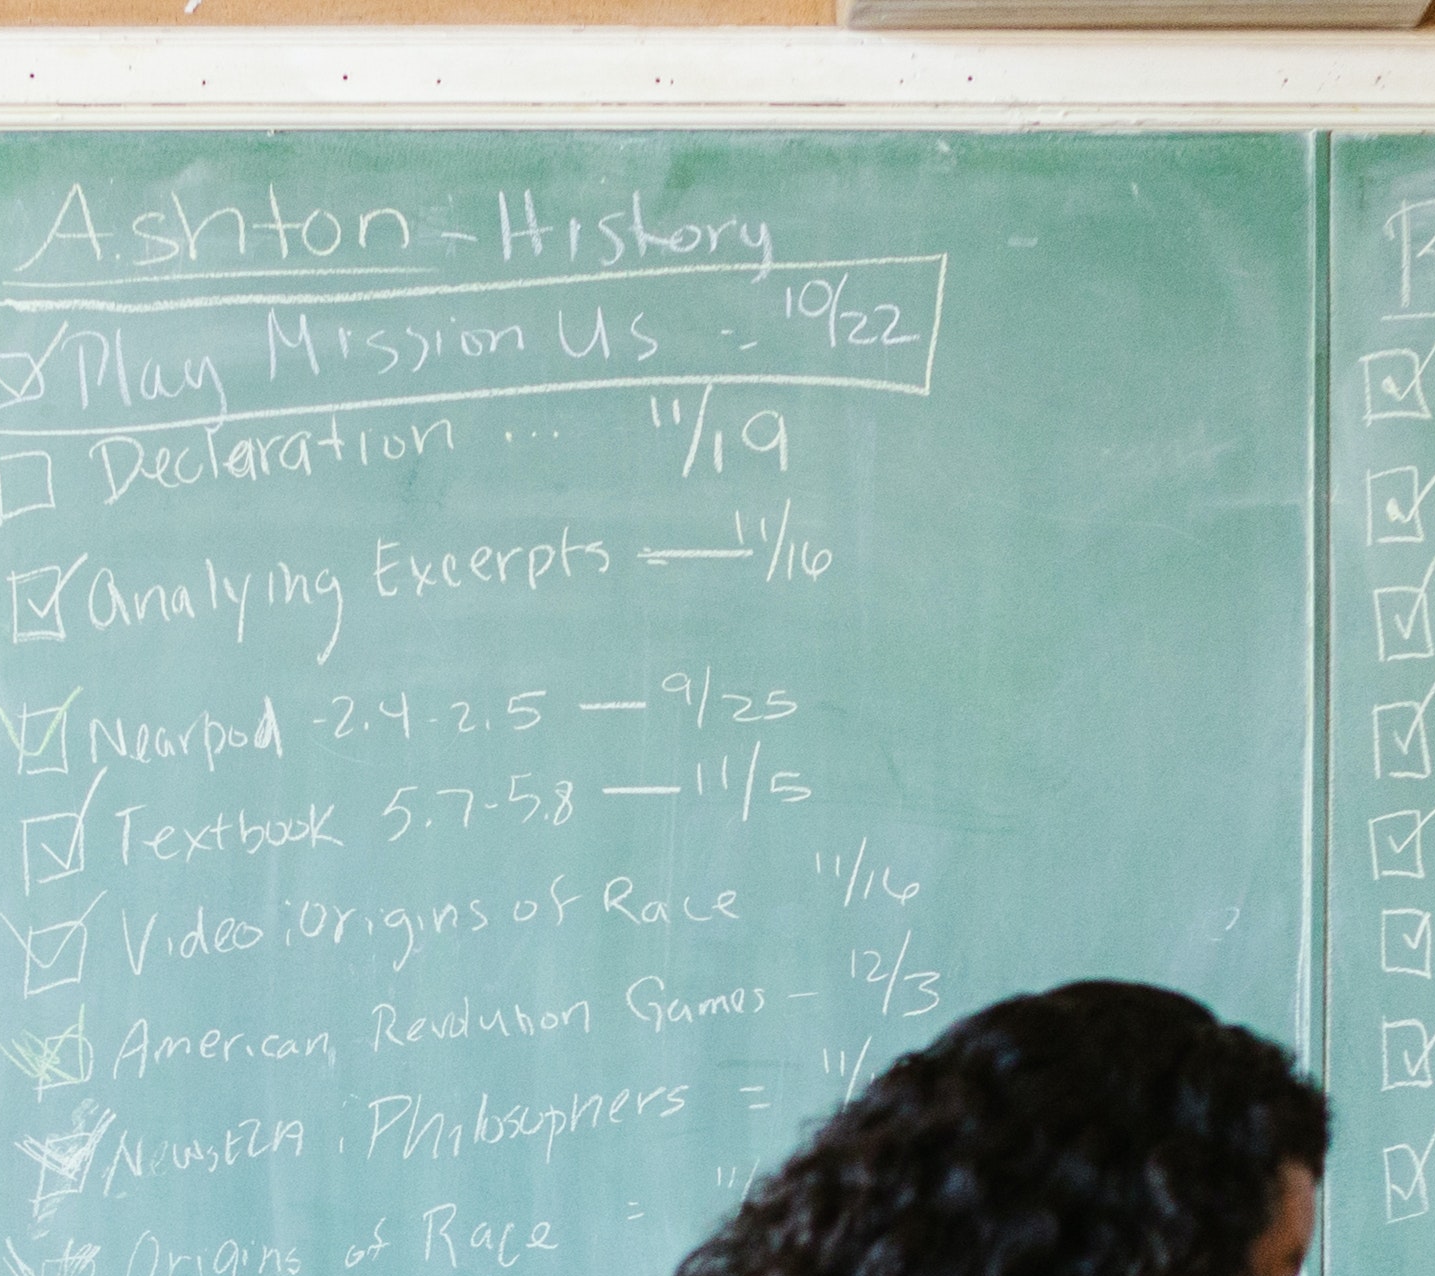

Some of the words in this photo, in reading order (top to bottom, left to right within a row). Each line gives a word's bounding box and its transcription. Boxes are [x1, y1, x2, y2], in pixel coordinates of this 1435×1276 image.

[14, 184, 410, 272] Ashton
[499, 190, 773, 283] History
[63, 328, 228, 430] Play
[268, 306, 525, 380] Mission
[785, 273, 919, 347] 10/22
[90, 417, 455, 505] Declaration
[650, 382, 789, 478] 11/19
[376, 526, 610, 597] Excerpts
[734, 500, 832, 582] 11/16
[89, 696, 283, 771] Nearpod
[661, 665, 798, 729] 9/25
[115, 804, 344, 866] Textbook
[696, 741, 813, 821] 11/5
[513, 875, 581, 925] of
[604, 876, 739, 924] Race
[815, 837, 920, 907] 11/16
[114, 1018, 329, 1079] American
[371, 996, 590, 1051] Revolution
[626, 976, 766, 1032] Games
[851, 930, 940, 1016] 12/3
[345, 1218, 391, 1268] of
[424, 1203, 559, 1268] Race
